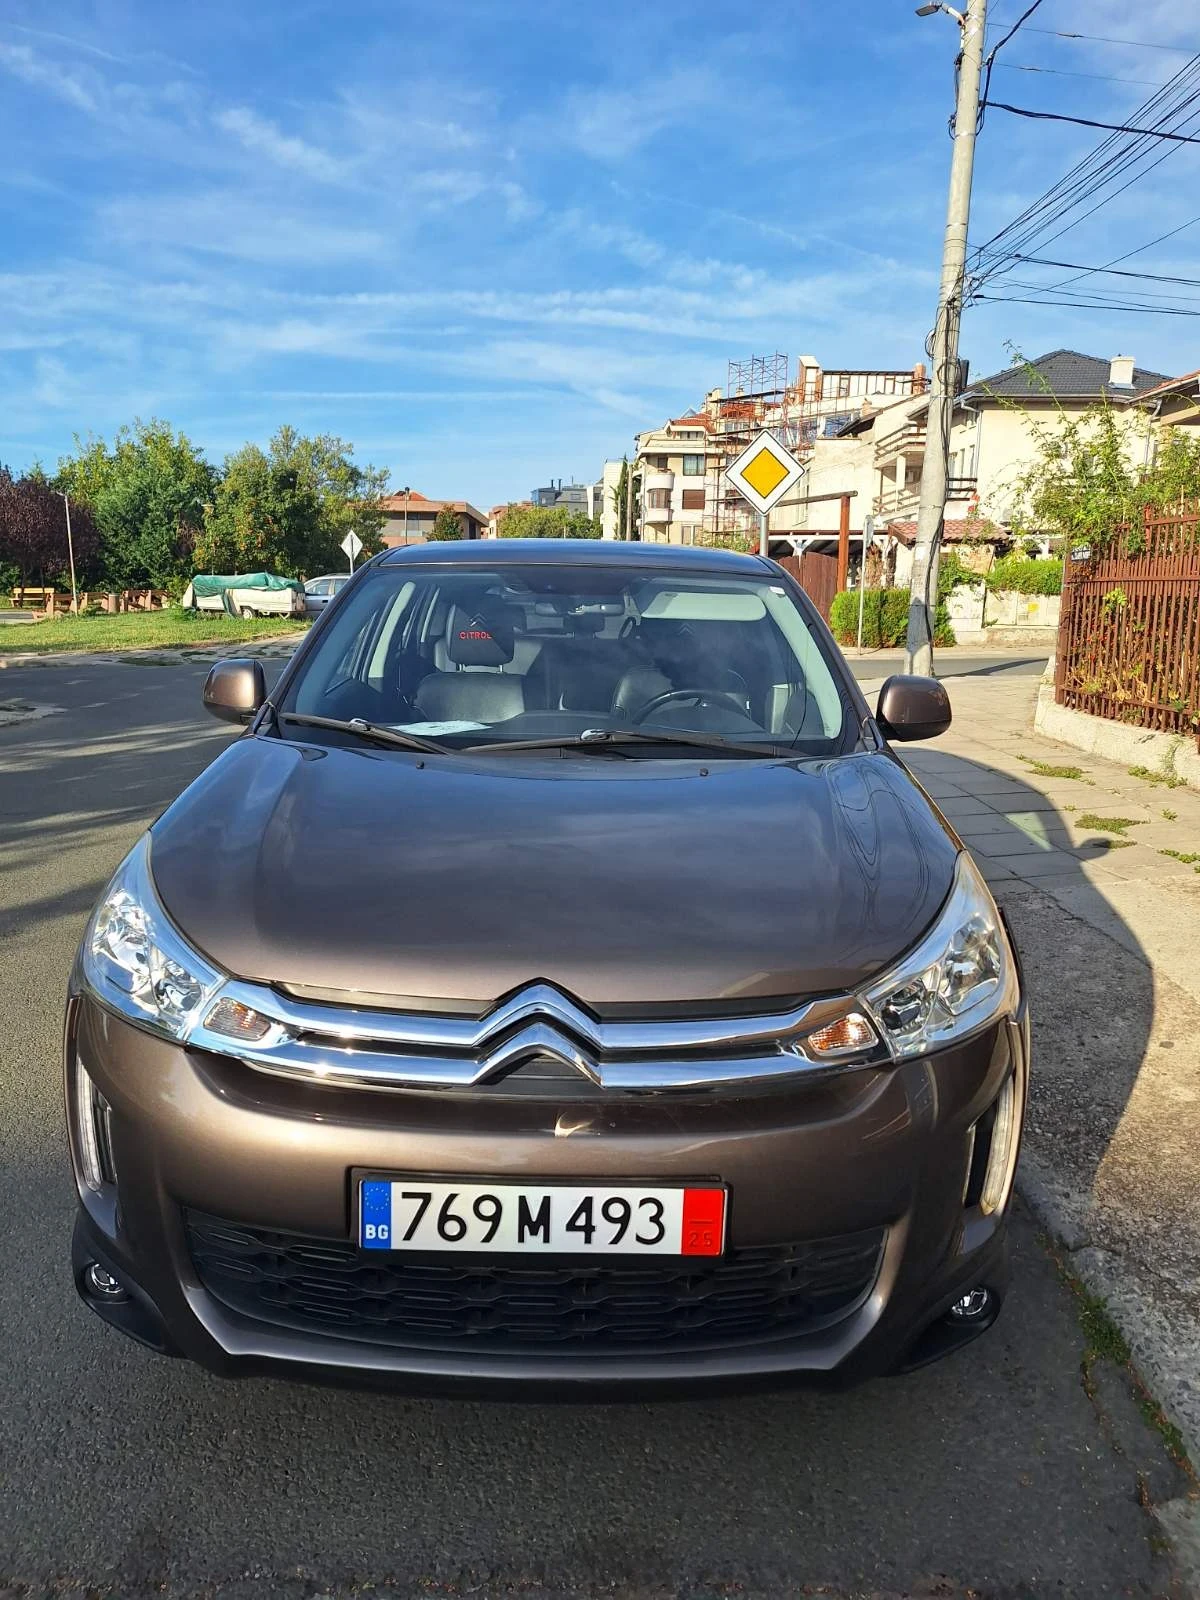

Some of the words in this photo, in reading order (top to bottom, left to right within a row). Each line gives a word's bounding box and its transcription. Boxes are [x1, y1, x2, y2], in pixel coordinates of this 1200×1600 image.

[365, 1224, 388, 1240] BG
[402, 1191, 503, 1243] 769
[518, 1195, 551, 1243] M
[566, 1195, 665, 1245] 493
